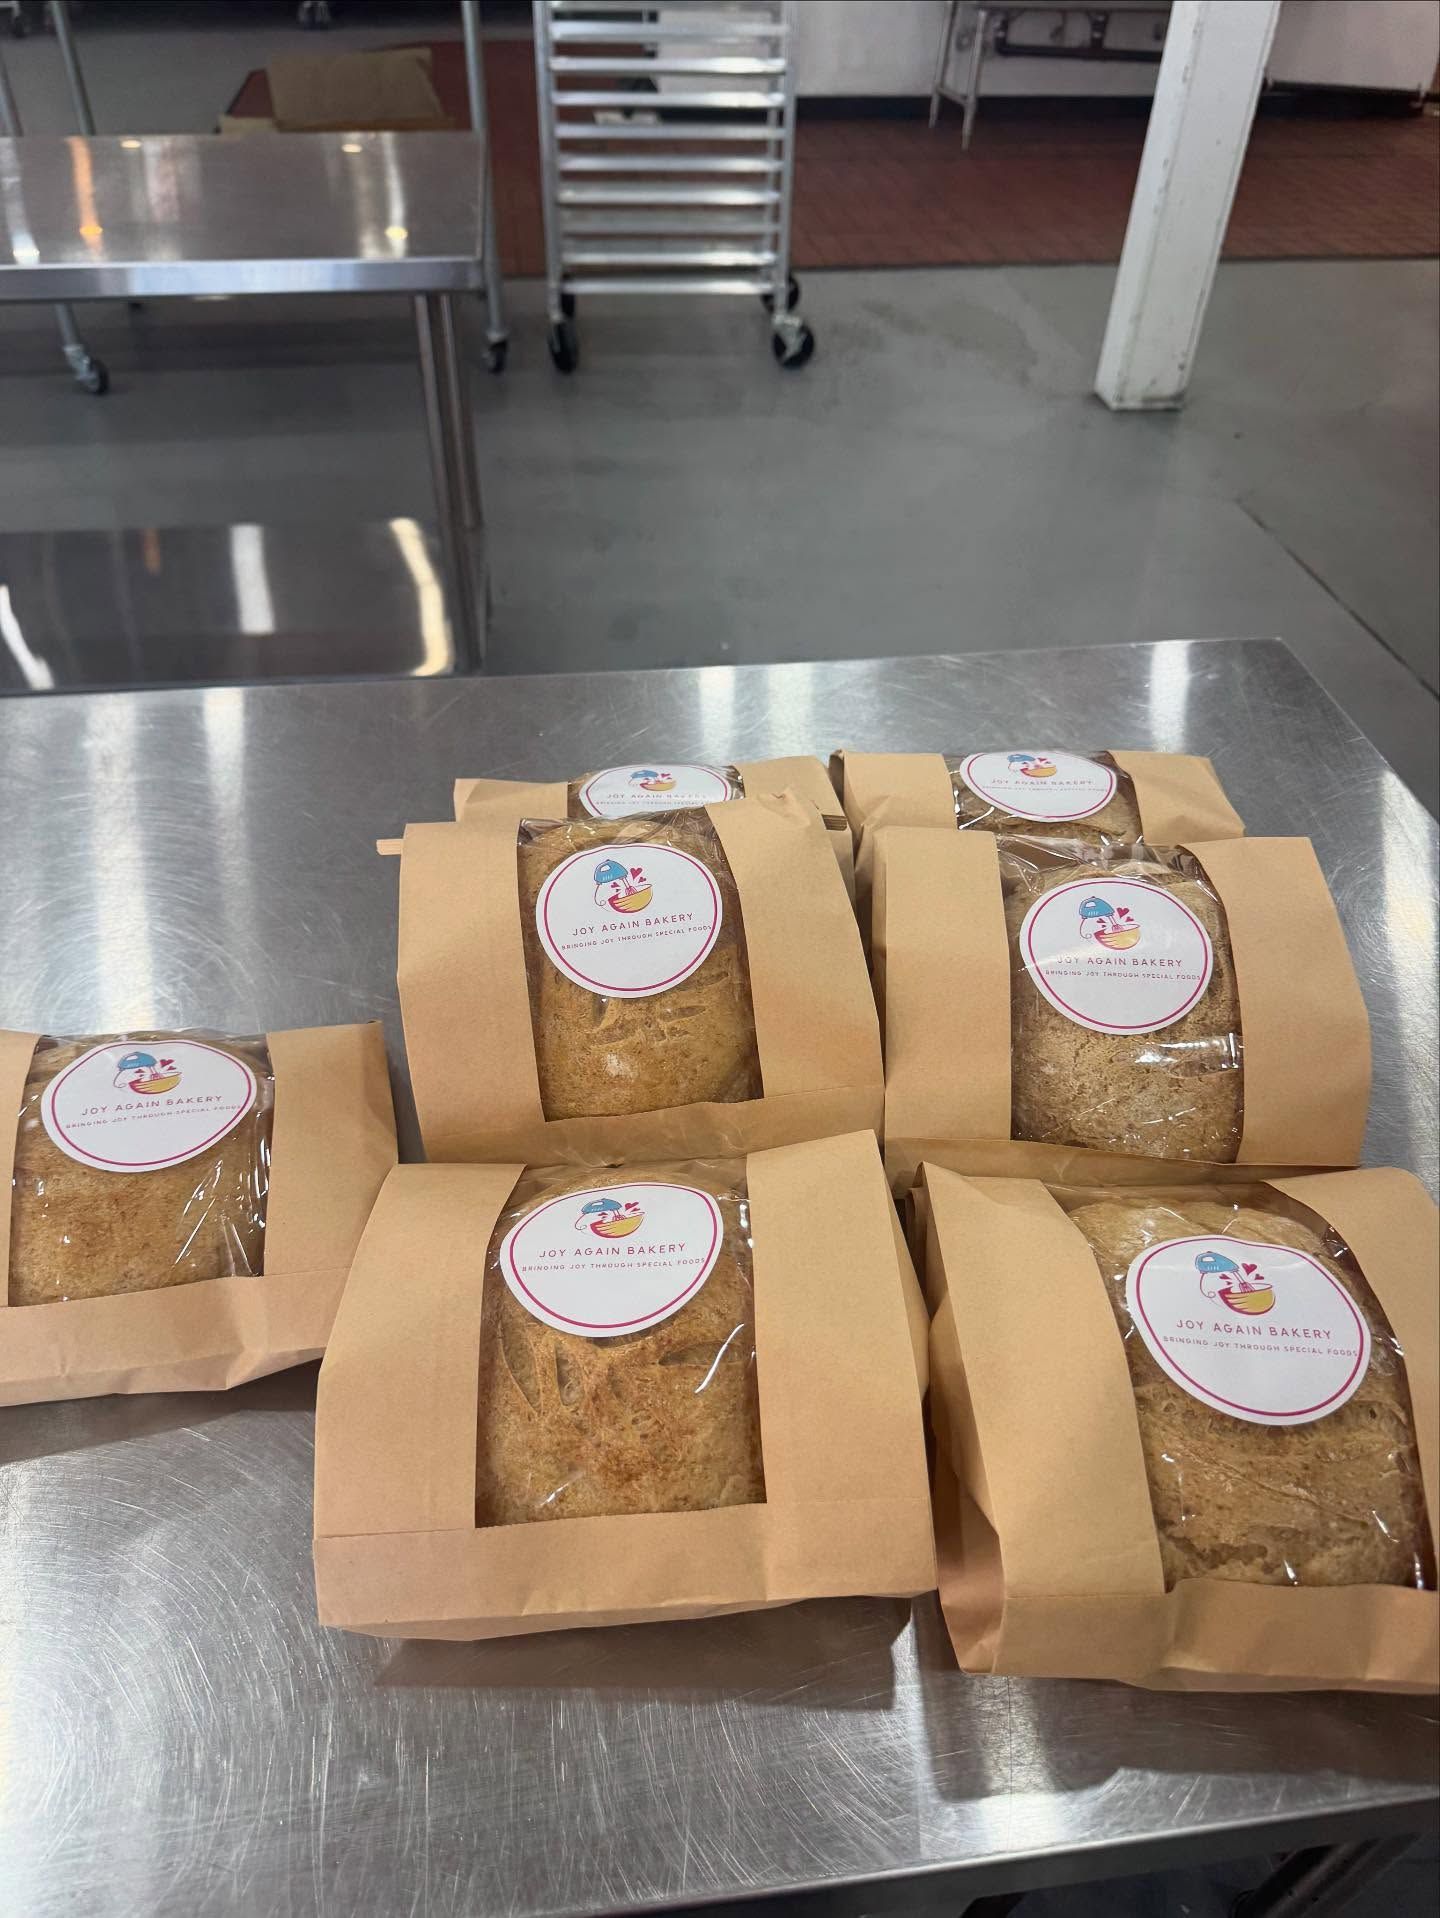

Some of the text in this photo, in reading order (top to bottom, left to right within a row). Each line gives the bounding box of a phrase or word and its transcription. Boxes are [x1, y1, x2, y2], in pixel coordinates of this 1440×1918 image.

[573, 913, 694, 937] JOY AGAIN BAKERY
[562, 941, 598, 951] BRINGING
[618, 933, 653, 943] THROUGH
[656, 929, 685, 937] SPECIAL
[1057, 957, 1183, 968] JOY AGAIN BAKERY
[82, 1095, 222, 1117] JOY AGAIN BAKERY
[132, 1112, 173, 1121] THROUGH
[540, 1243, 686, 1259] JOY AGAIN BAKERY
[522, 1264, 566, 1273] BRINGING
[677, 1258, 706, 1266] FOODS
[1177, 1320, 1332, 1340] JOY AGAIN BAKERY
[1164, 1336, 1358, 1357] BRINGING JOY THROUGH SPECIAL FOODS
